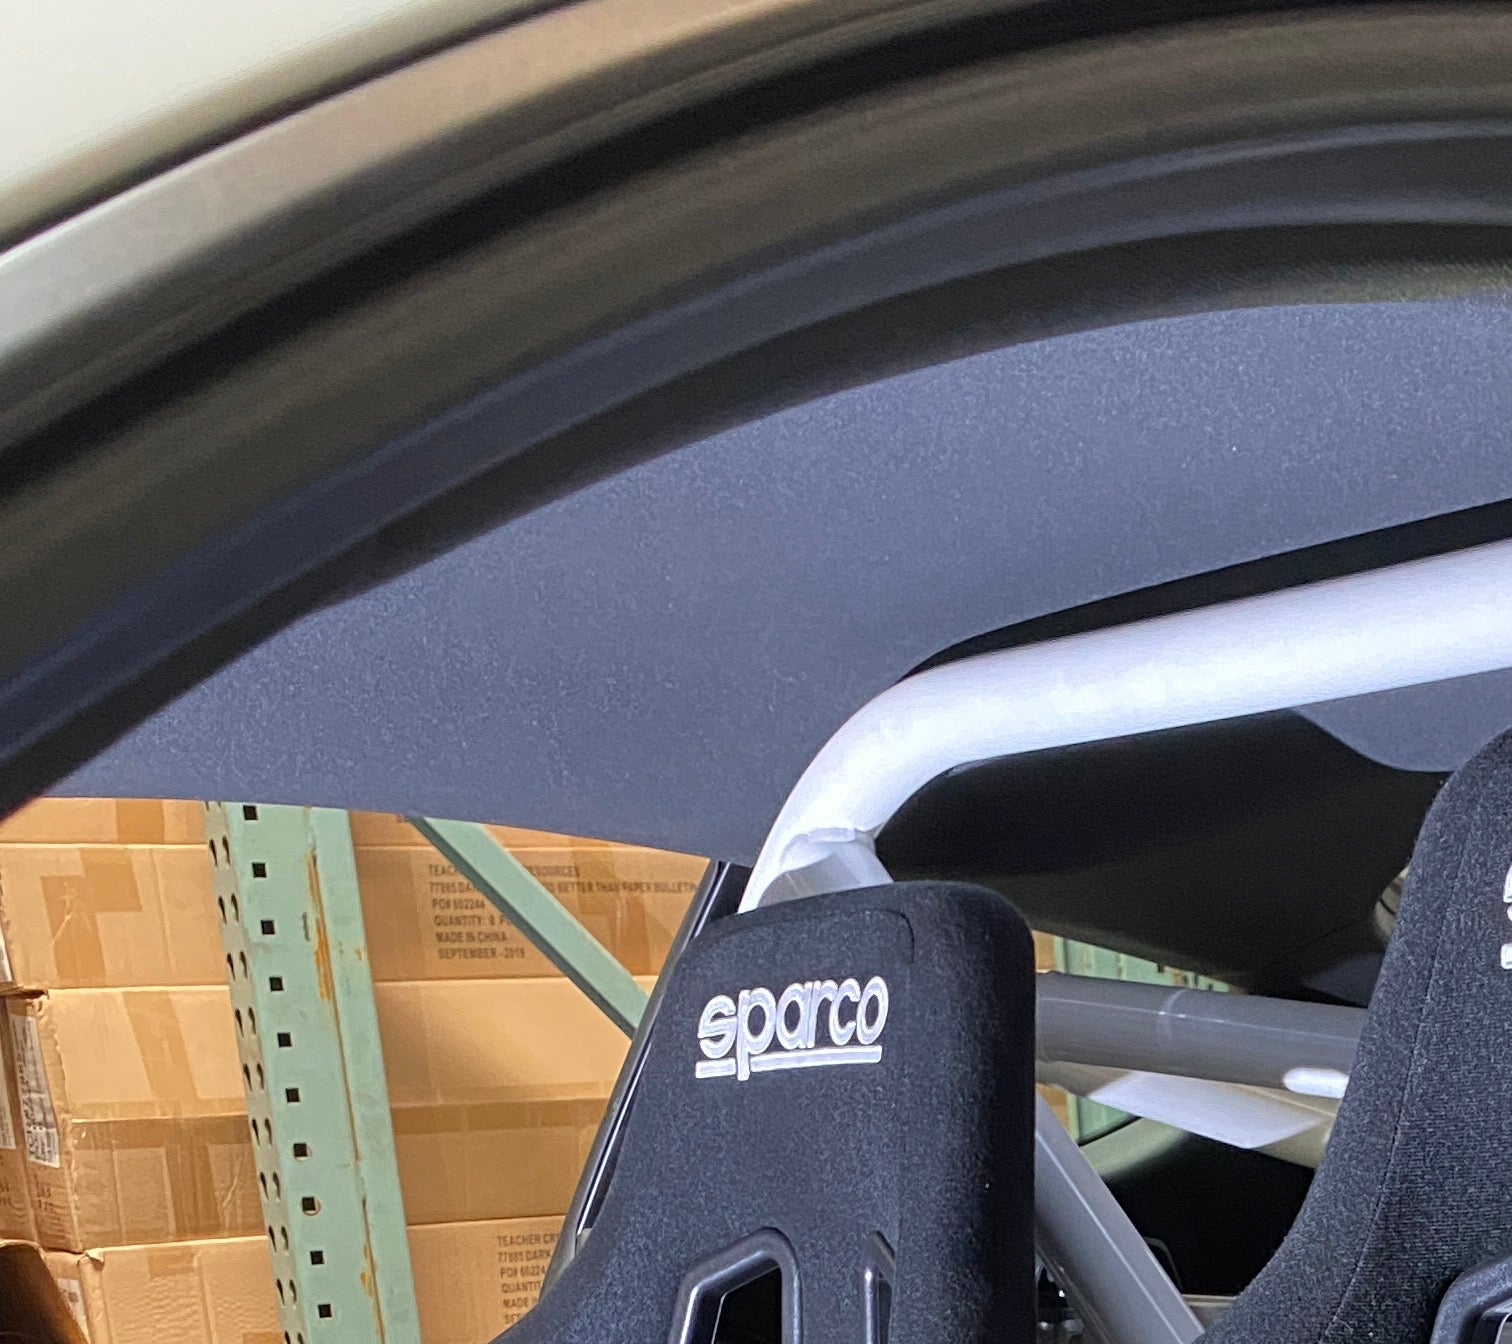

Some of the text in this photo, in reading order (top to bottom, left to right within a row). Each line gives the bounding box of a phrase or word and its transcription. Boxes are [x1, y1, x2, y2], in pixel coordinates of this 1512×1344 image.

[436, 932, 463, 943] MADE
[478, 932, 506, 943] CHINA
[695, 975, 889, 1082] sparco
[501, 1281, 540, 1293] QUANTIT
